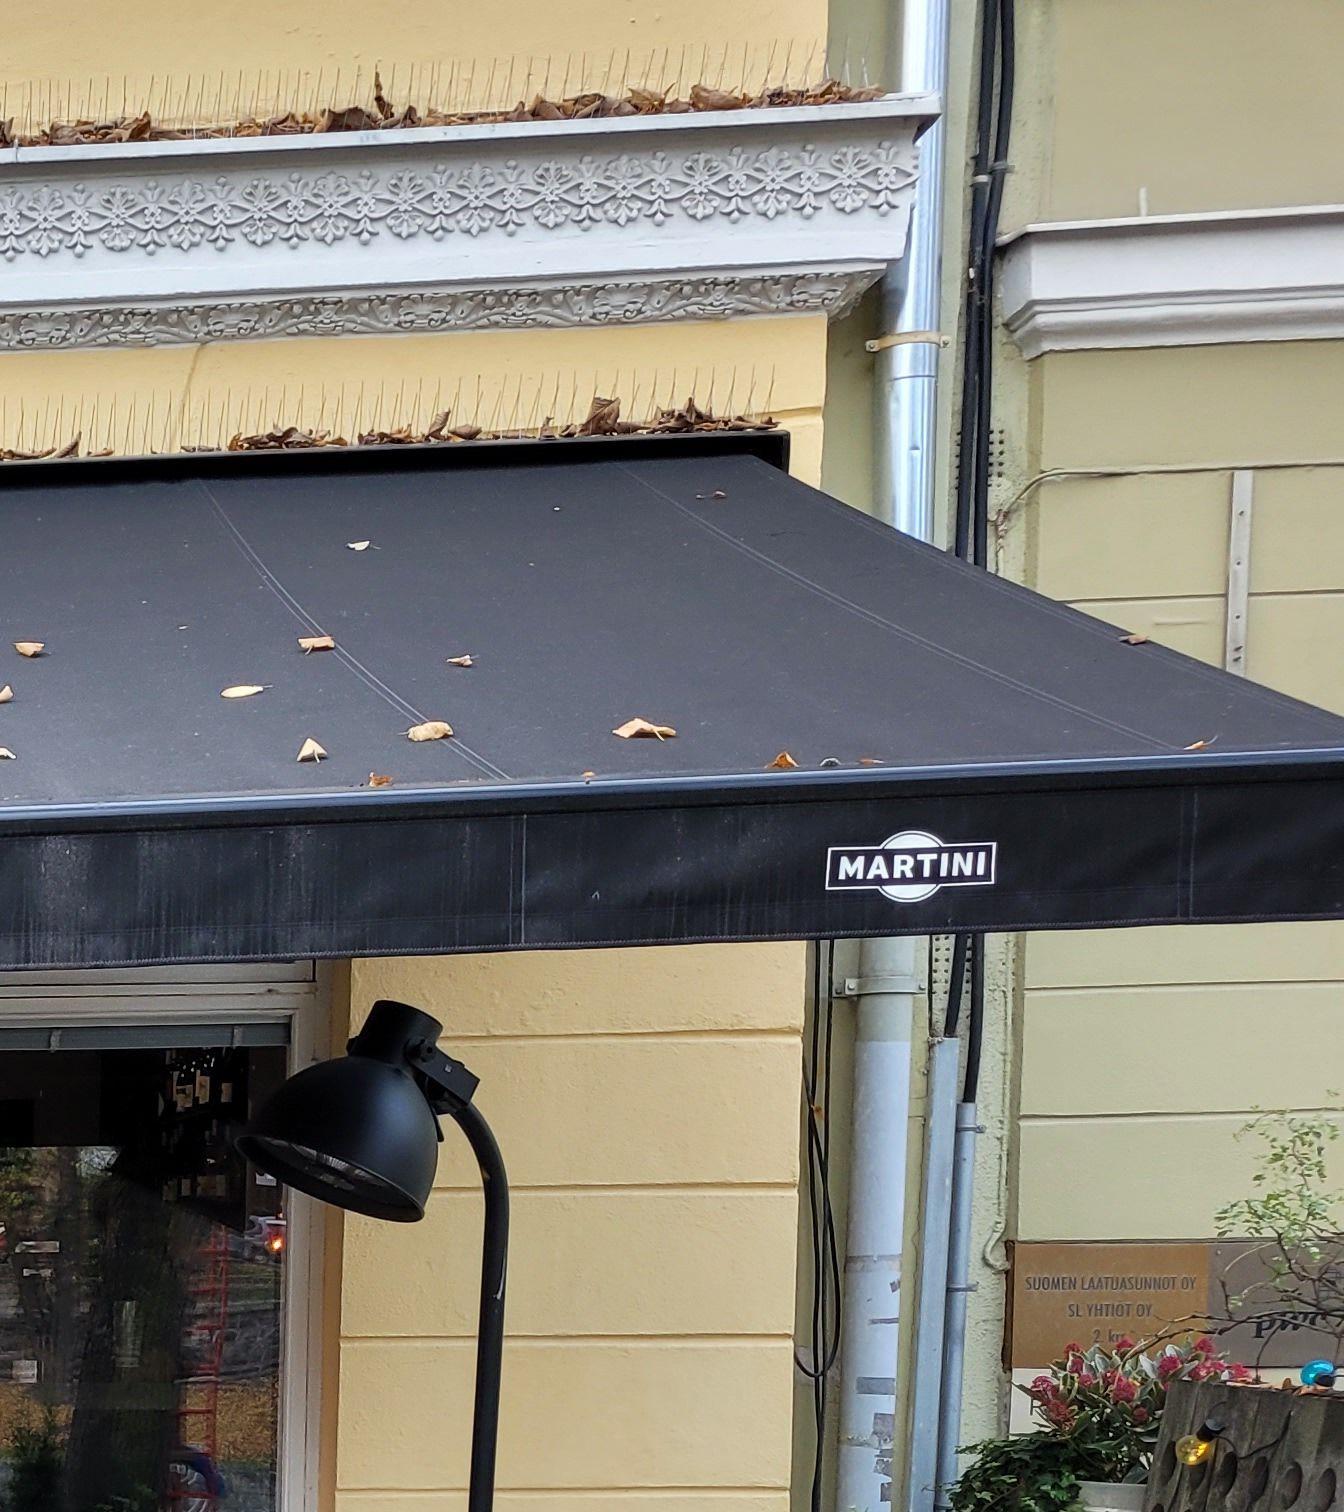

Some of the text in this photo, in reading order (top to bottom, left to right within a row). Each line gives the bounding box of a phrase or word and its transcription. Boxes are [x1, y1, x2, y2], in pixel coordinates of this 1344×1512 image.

[838, 851, 986, 880] MARTINI
[1025, 1275, 1197, 1290] SUOMEN LAATUASUNNOT OY
[1068, 1303, 1082, 1318] SL
[1136, 1303, 1153, 1317] OY
